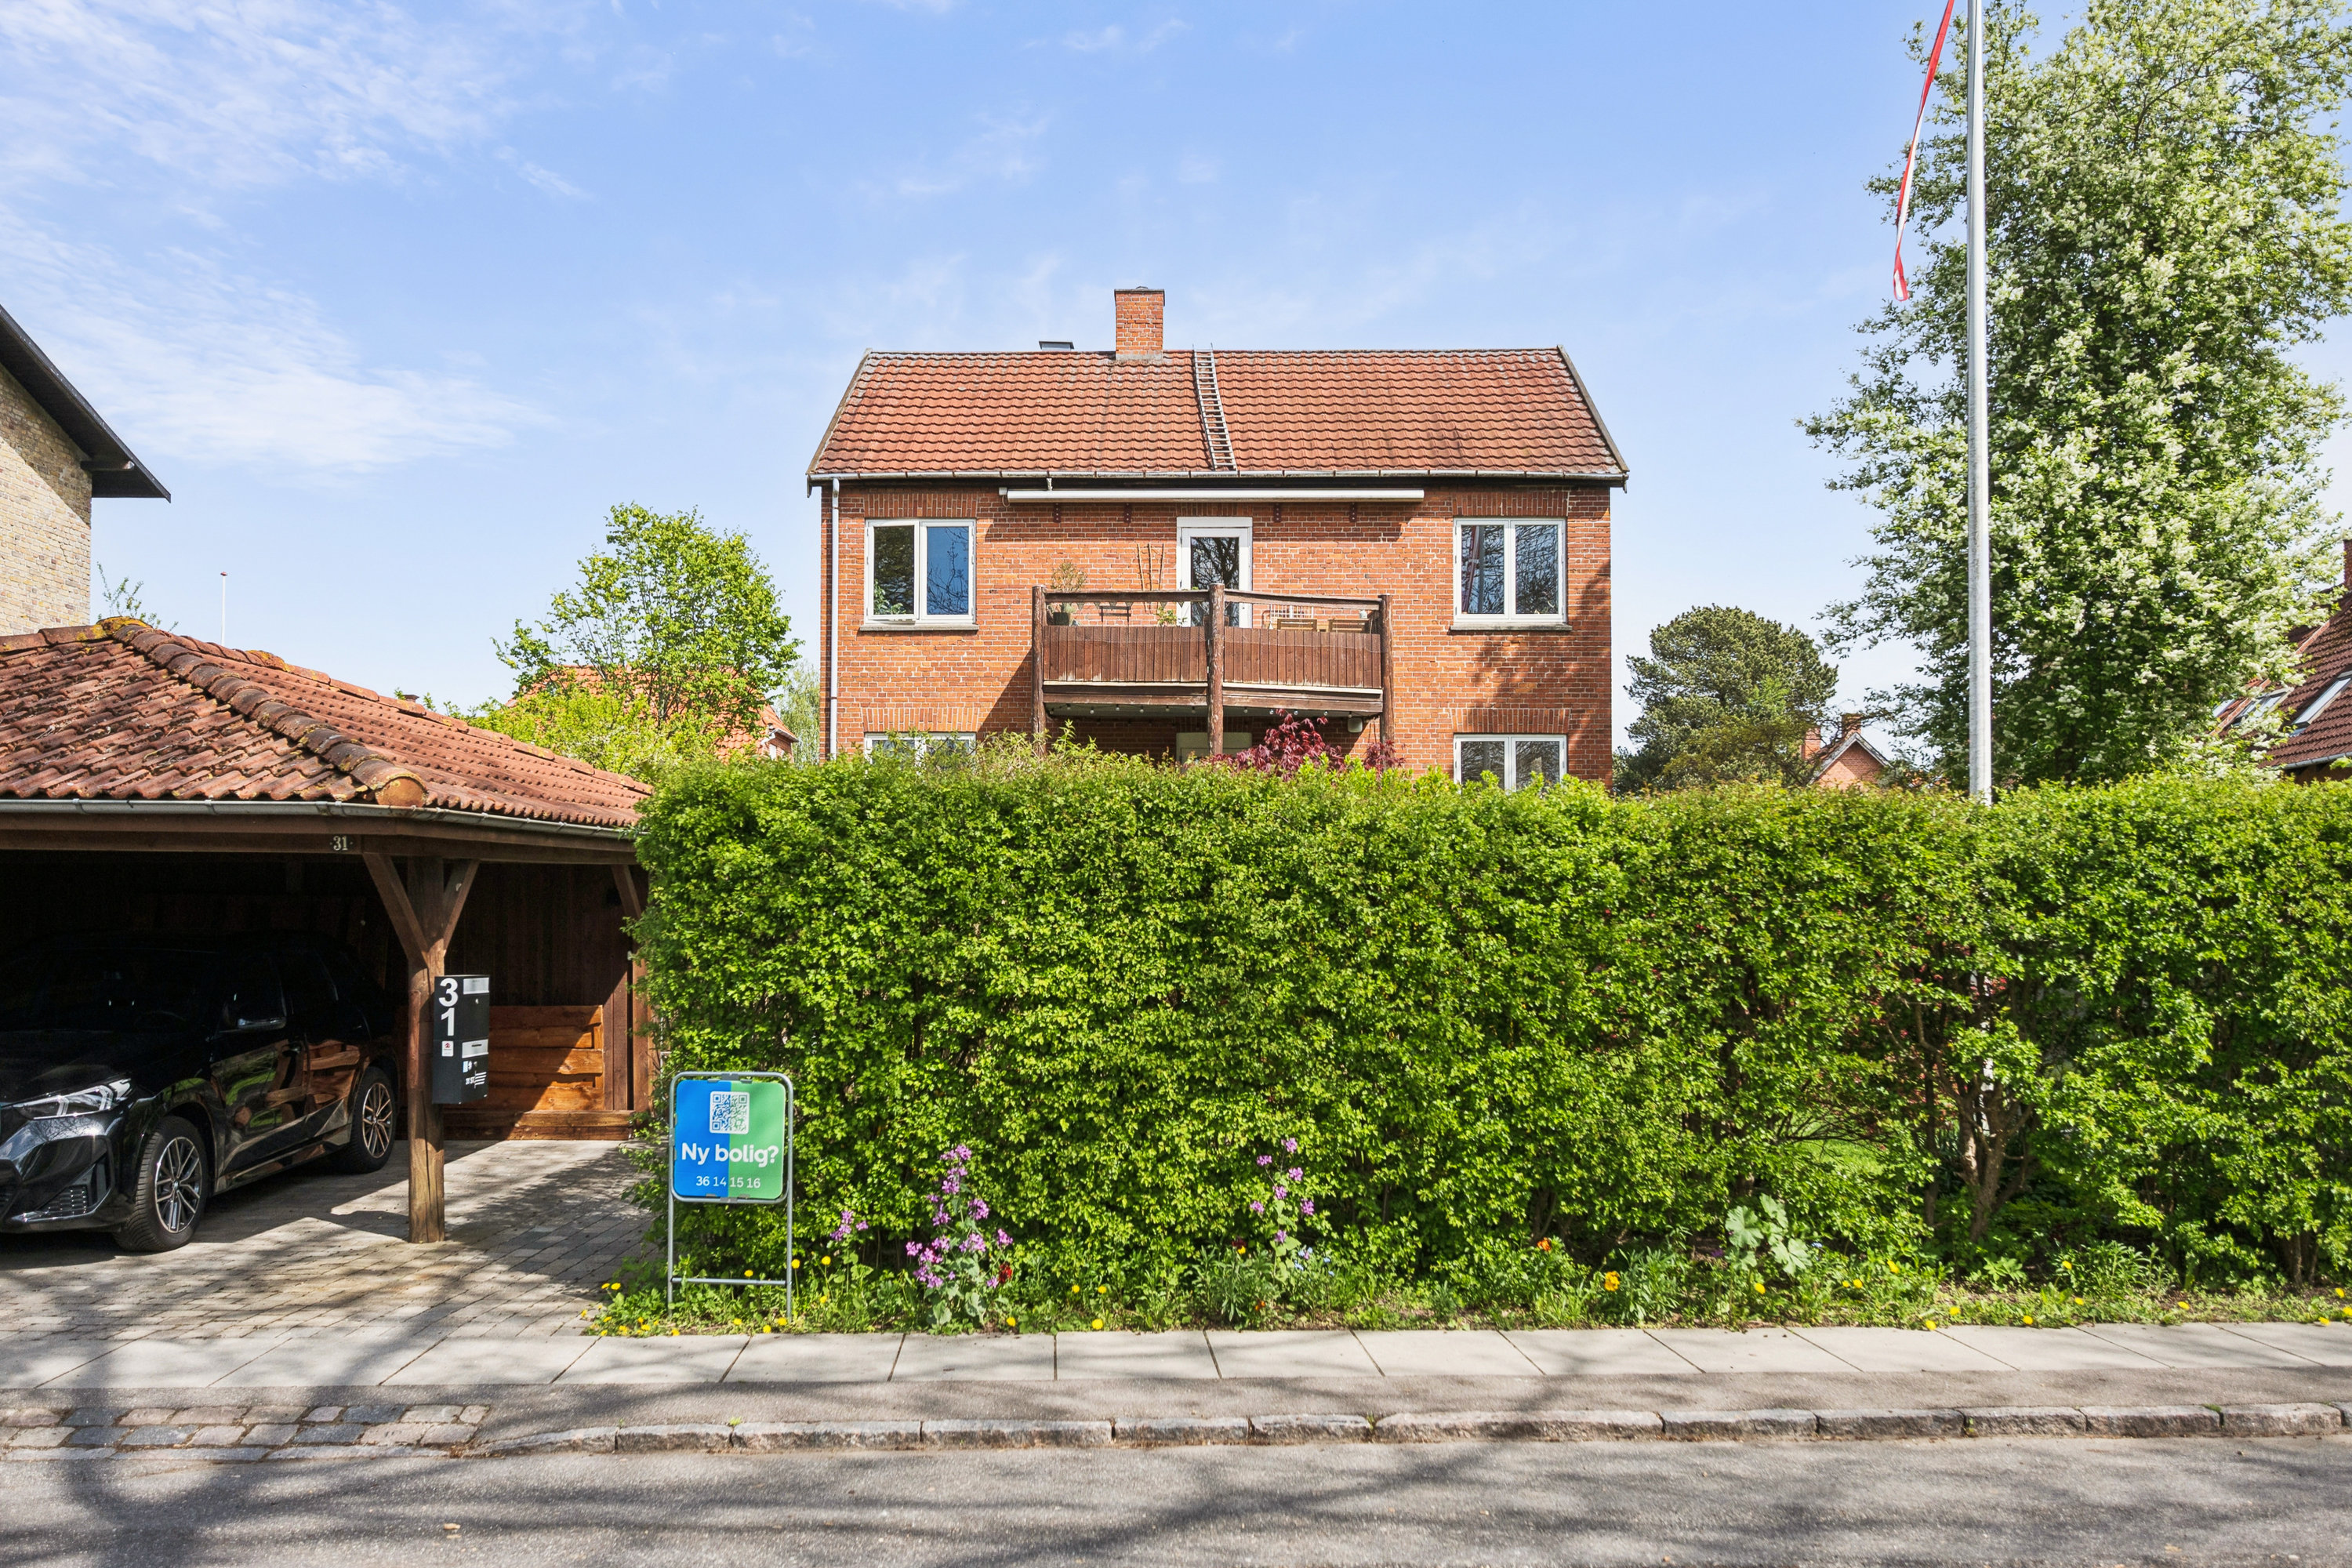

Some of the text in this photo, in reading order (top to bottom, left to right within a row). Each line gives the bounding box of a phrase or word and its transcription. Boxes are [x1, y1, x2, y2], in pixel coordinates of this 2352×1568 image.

[333, 836, 348, 851] 31
[681, 1142, 779, 1167] Ny bolig?
[696, 1176, 760, 1189] 36 14 15 16
